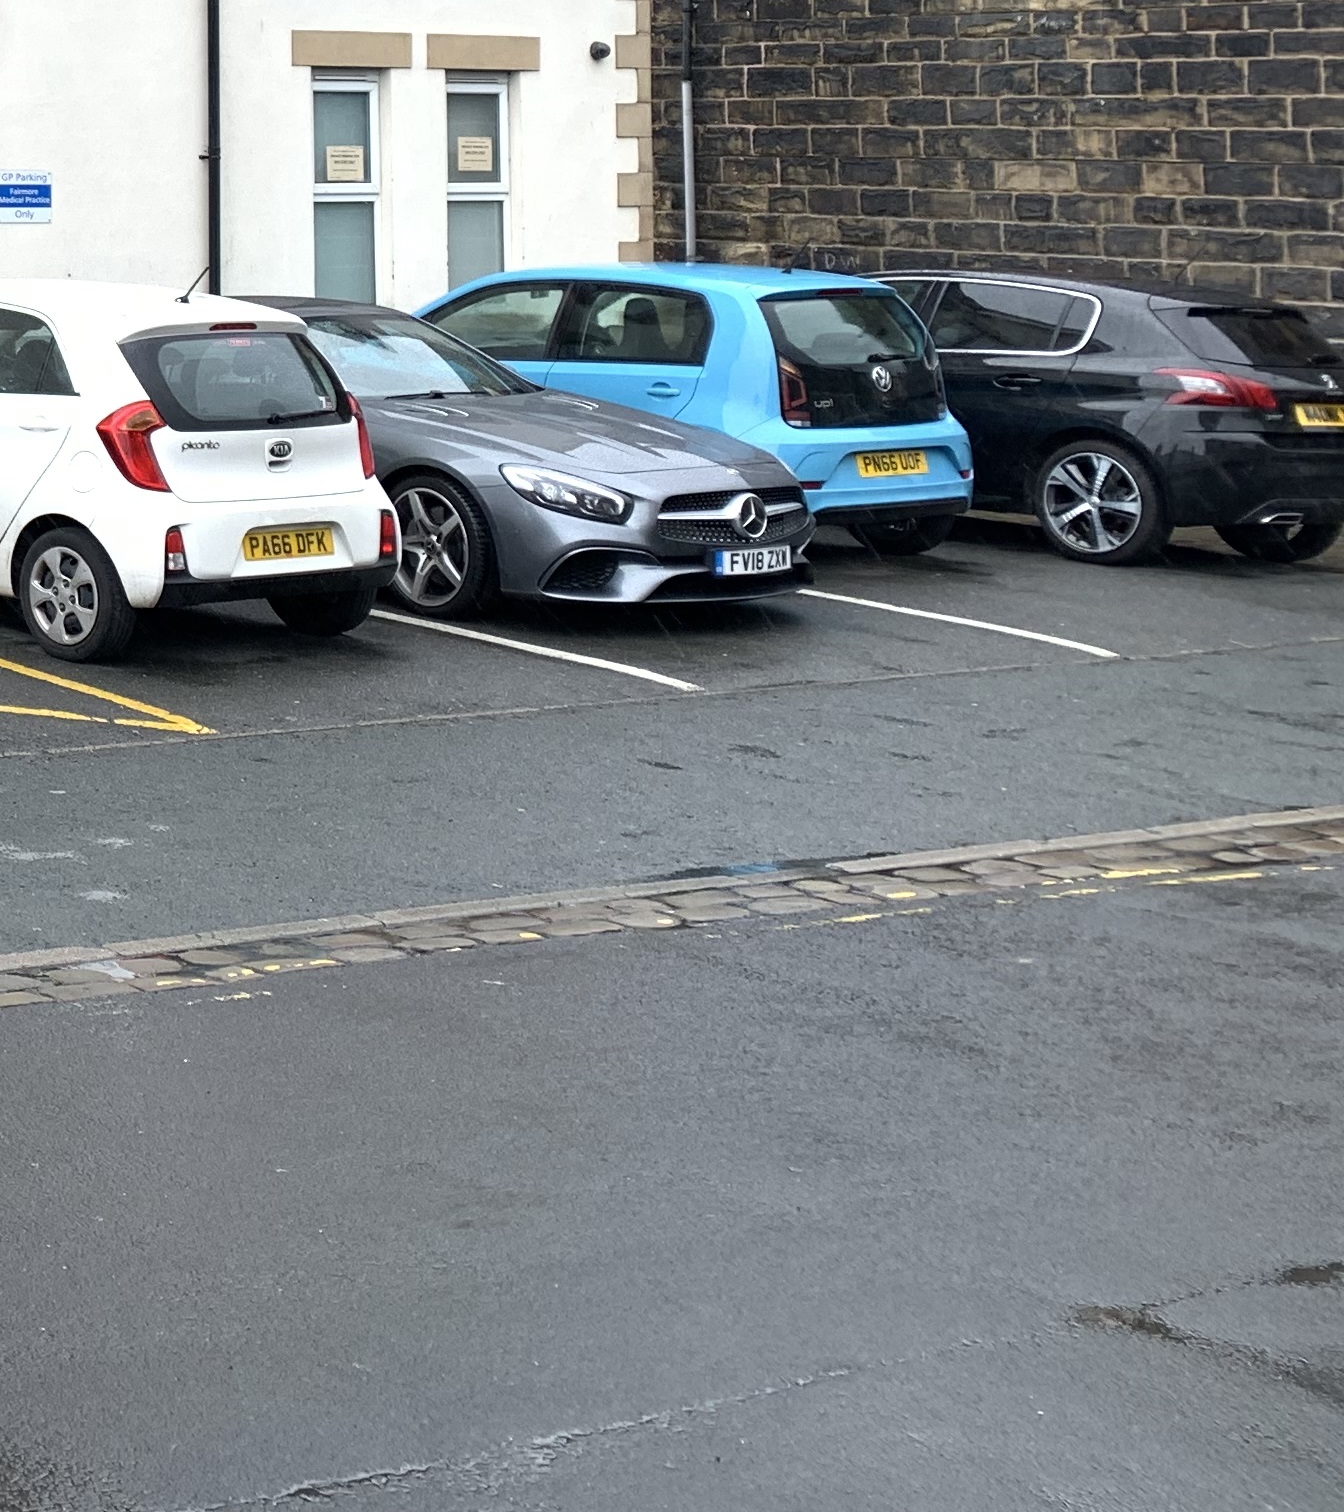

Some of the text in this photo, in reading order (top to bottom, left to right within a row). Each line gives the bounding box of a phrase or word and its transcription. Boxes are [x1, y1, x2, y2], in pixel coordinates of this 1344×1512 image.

[1, 173, 48, 183] GP Parking
[14, 210, 34, 220] Only
[272, 443, 291, 455] KIA
[862, 454, 898, 473] PN66
[248, 531, 328, 557] PA66 DFK
[730, 552, 764, 572] FV18
